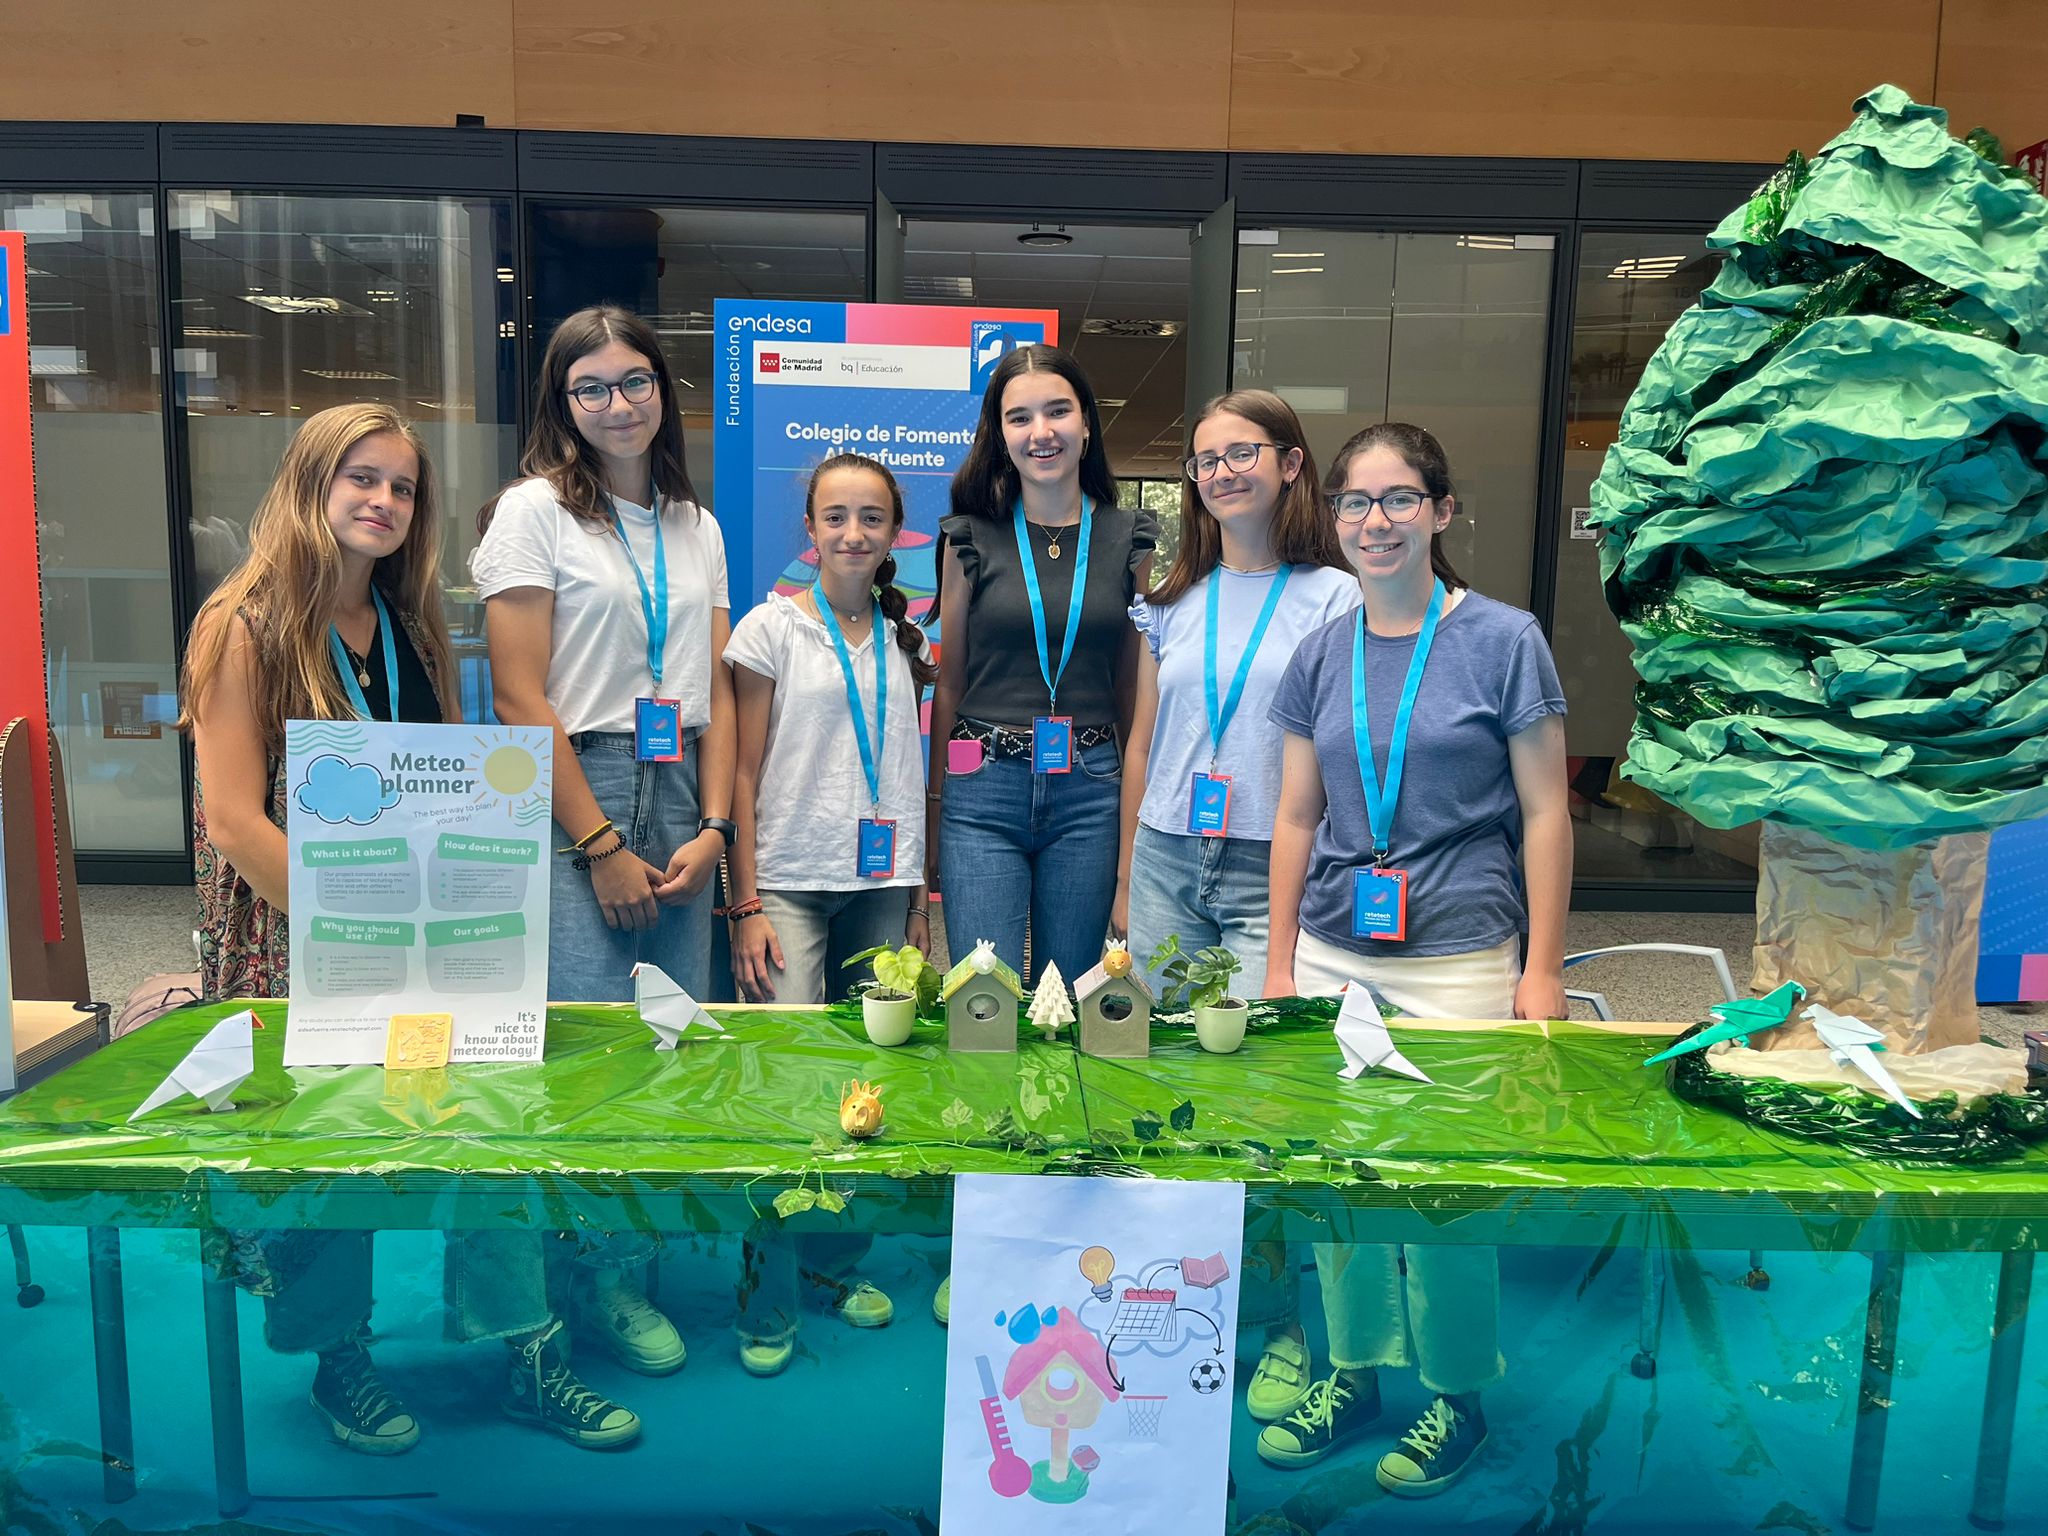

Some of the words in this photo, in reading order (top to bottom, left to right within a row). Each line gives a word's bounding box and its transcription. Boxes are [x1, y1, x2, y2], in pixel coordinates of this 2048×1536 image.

[728, 313, 811, 334] endesa
[782, 357, 823, 365] Comunidad
[840, 361, 853, 373] bq
[861, 364, 903, 373] Educación
[794, 364, 823, 372] Madrid
[726, 334, 740, 426] Fundación
[785, 422, 861, 445] Colegio
[866, 425, 890, 443] de
[390, 752, 465, 772] Meteo
[380, 773, 475, 798] planner
[414, 809, 429, 819] The
[430, 807, 448, 817] best
[449, 806, 464, 816] way
[466, 804, 474, 812] to
[475, 802, 492, 812] plan
[435, 817, 453, 826] your
[455, 814, 472, 824] day!
[312, 849, 340, 859] What
[342, 848, 350, 858] is
[353, 848, 361, 857] it
[363, 847, 397, 857] about?
[444, 840, 466, 850] How
[468, 842, 490, 852] does
[492, 844, 501, 853] it
[502, 847, 532, 856] work?
[321, 921, 343, 932] Why
[346, 924, 364, 933] you
[367, 924, 399, 934] should
[453, 928, 471, 936] Our
[474, 924, 500, 936] goals
[345, 932, 362, 941] use
[364, 932, 377, 941] it?
[518, 1012, 537, 1022] It's
[495, 1022, 519, 1033] nice
[523, 1023, 536, 1033] to
[464, 1034, 498, 1045] know
[502, 1034, 539, 1045] about
[453, 1045, 537, 1058] meteorology!
